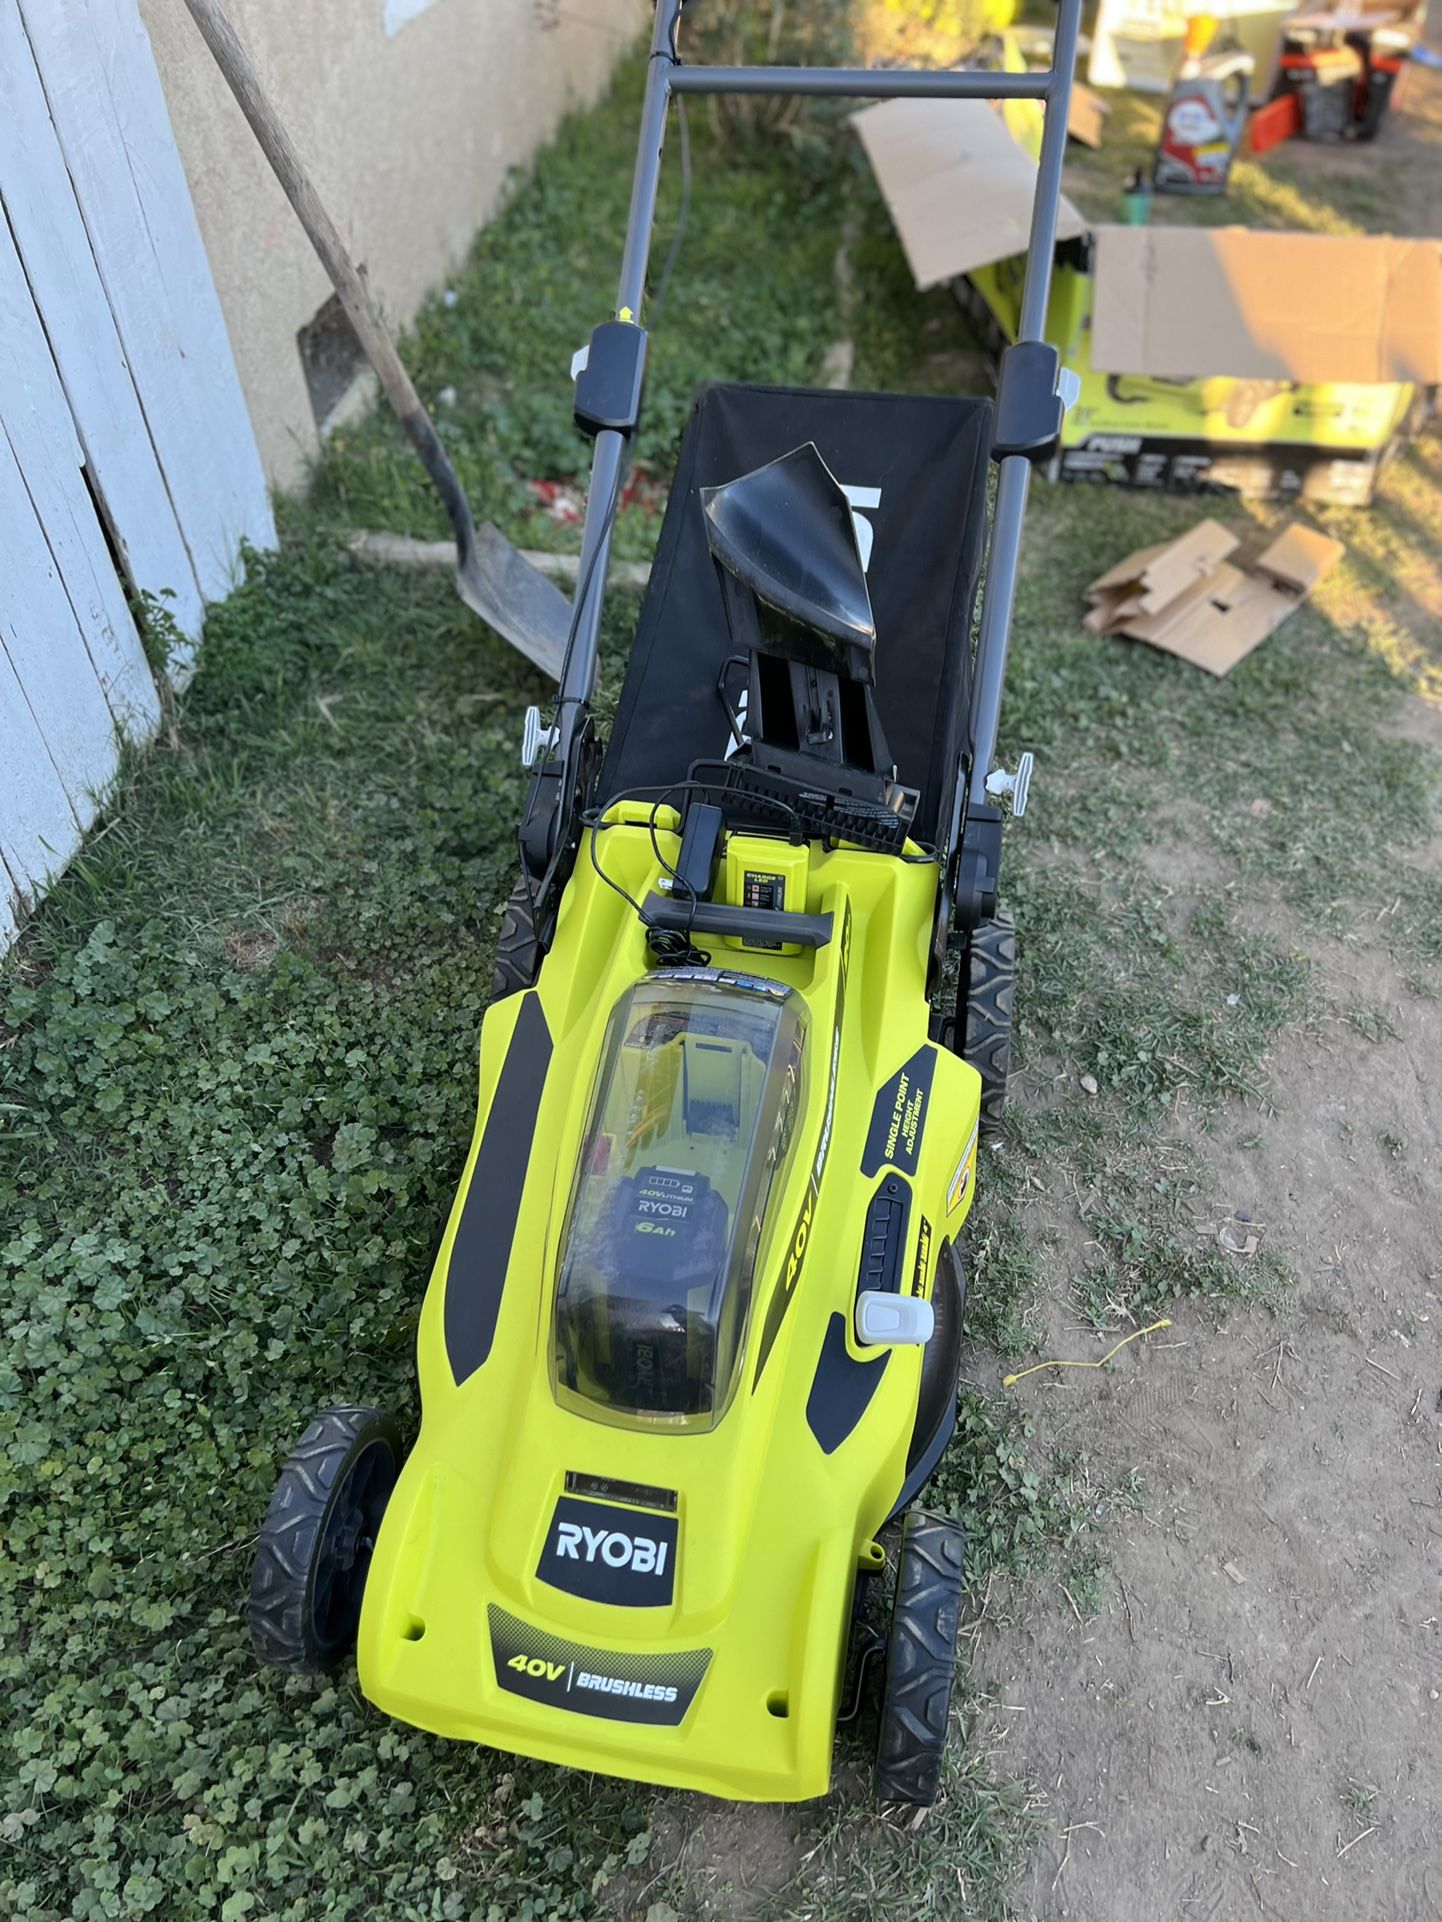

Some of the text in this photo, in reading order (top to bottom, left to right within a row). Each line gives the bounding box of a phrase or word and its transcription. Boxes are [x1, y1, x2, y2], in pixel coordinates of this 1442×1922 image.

[885, 1072, 909, 1160] SINGLE POINT
[902, 1099, 914, 1138] HEIGHT
[905, 1087, 923, 1156] ADJUSTMENT
[639, 1200, 688, 1218] RYOBI
[640, 1189, 664, 1197] 40V
[785, 1195, 813, 1291] 40V
[556, 1522, 668, 1576] RYOBI
[507, 1654, 678, 1702] 40V BRUSHLESS
